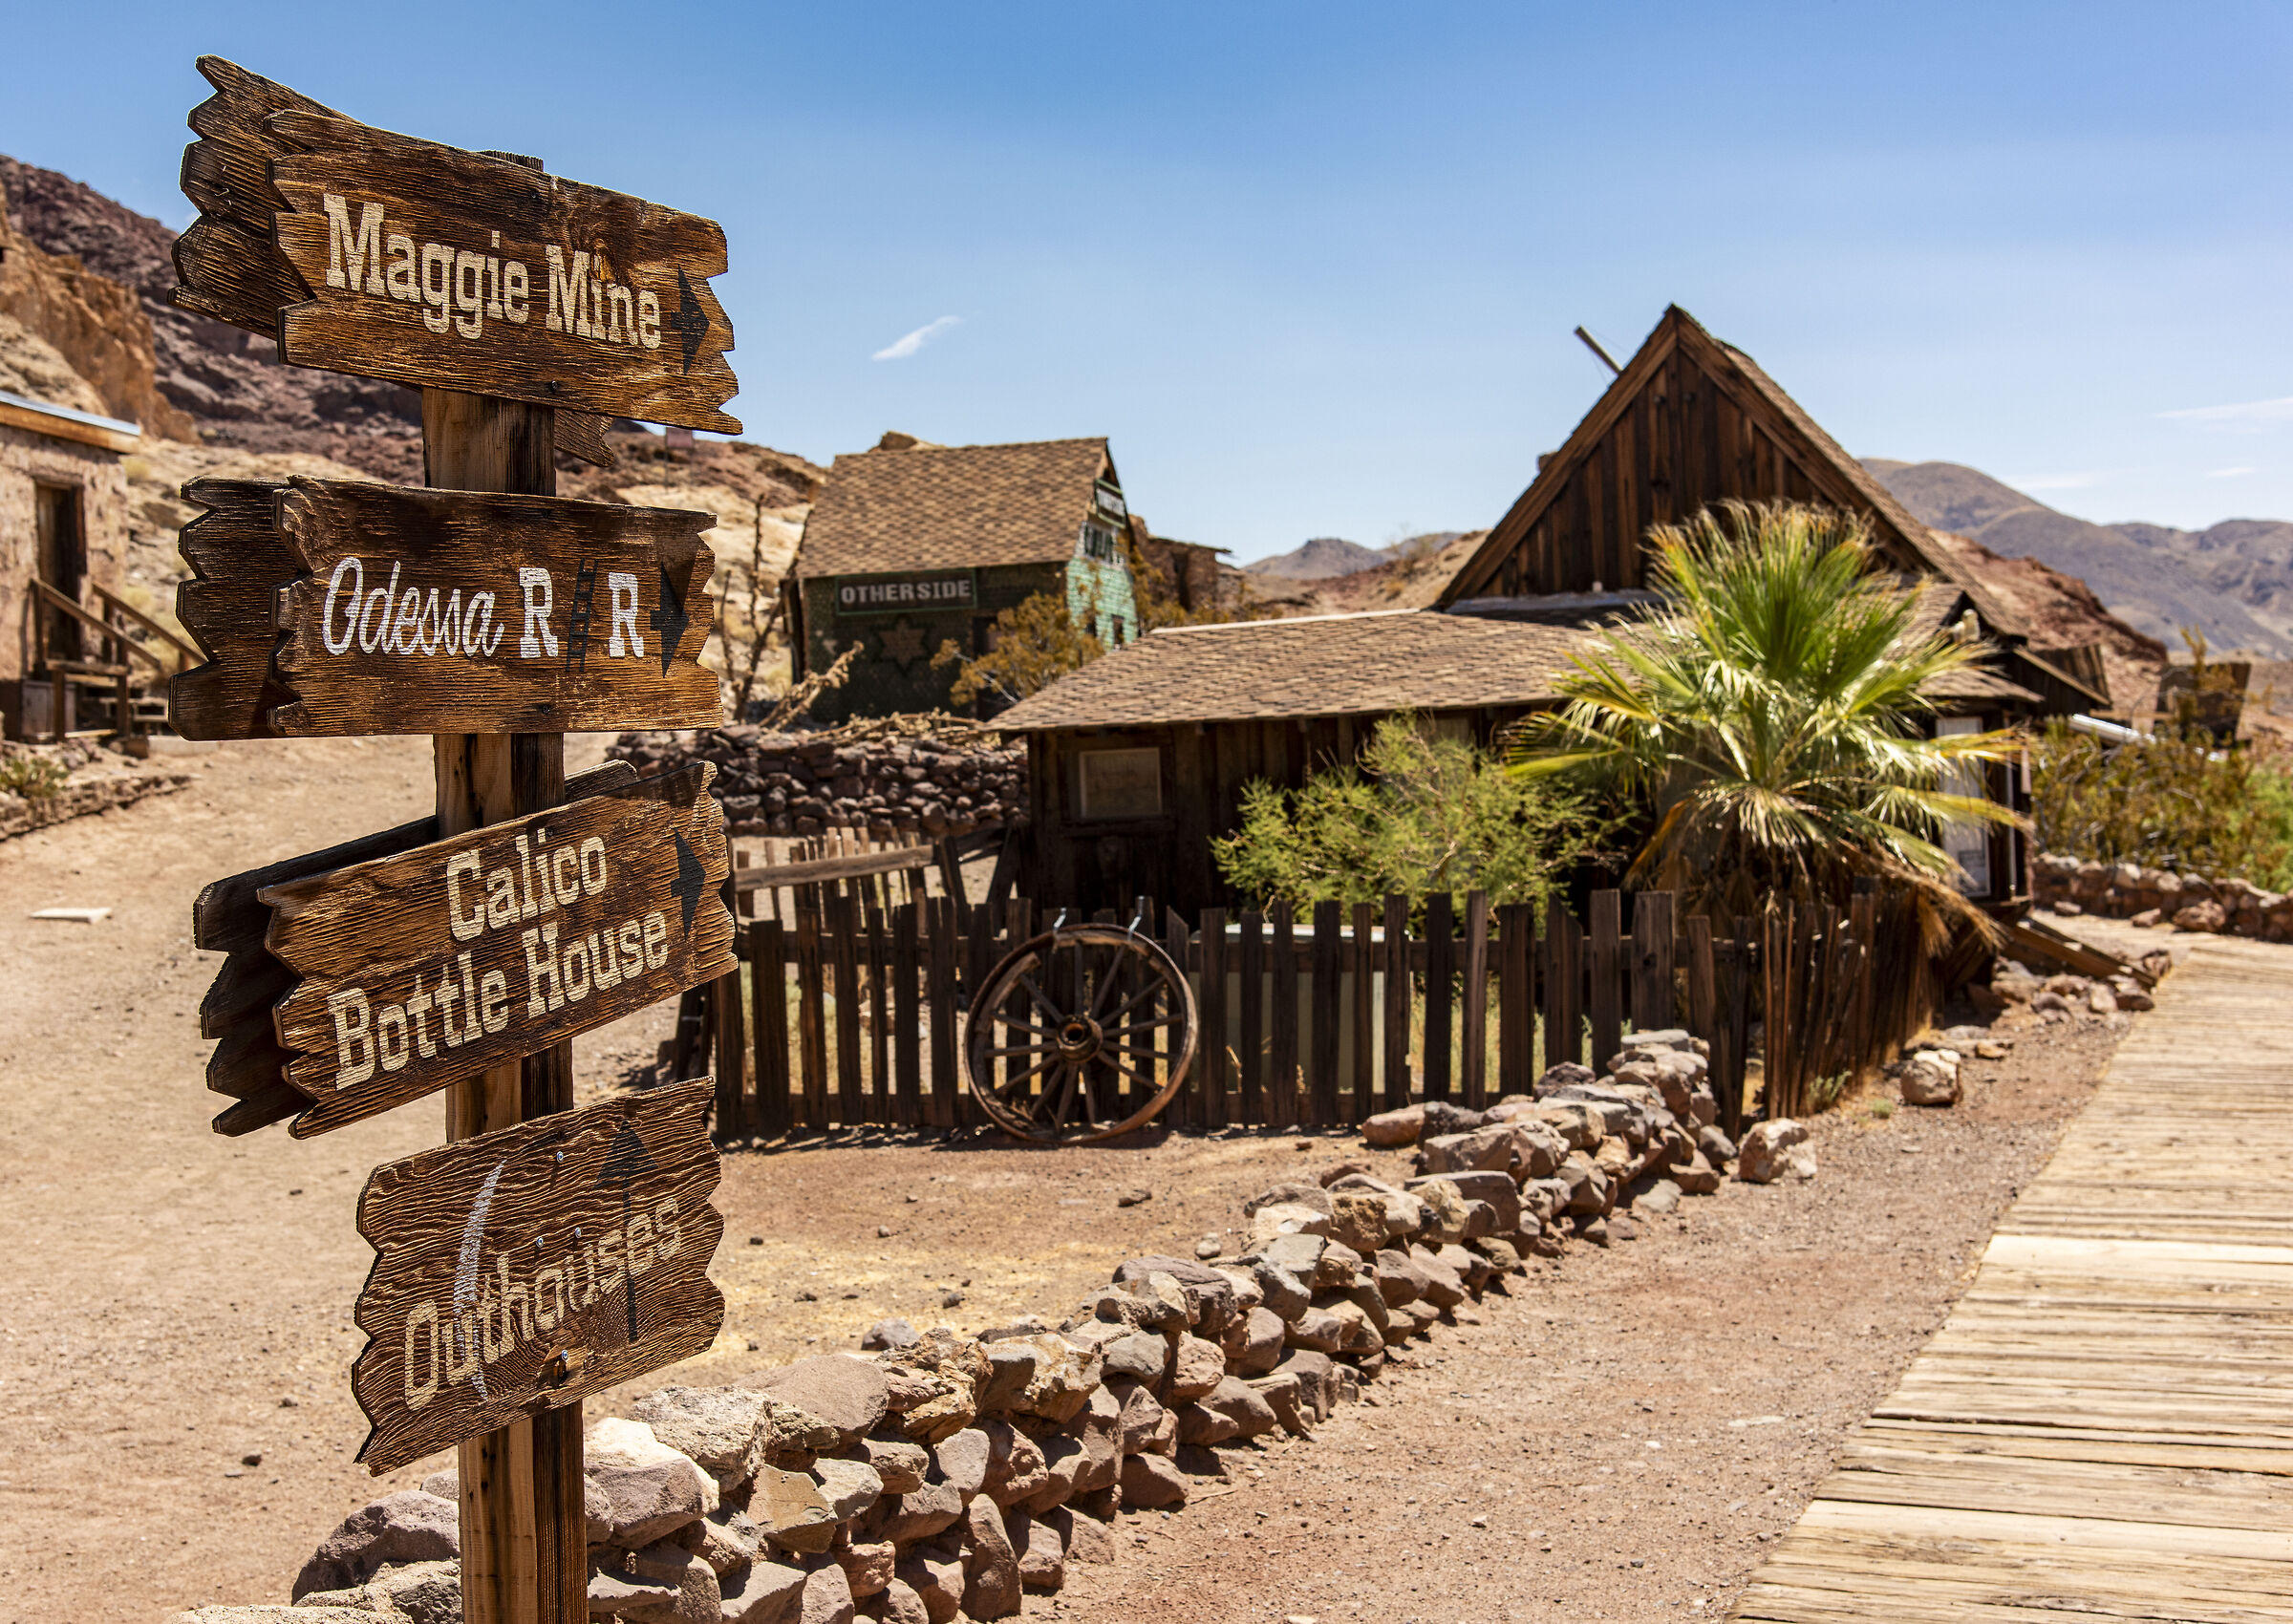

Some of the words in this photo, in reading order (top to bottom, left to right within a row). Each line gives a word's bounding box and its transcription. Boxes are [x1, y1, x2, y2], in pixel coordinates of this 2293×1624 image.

[323, 194, 529, 339] Maggie
[546, 245, 663, 350] Mine
[321, 556, 505, 659] Odessa
[519, 566, 560, 659] R
[608, 572, 645, 659] R
[446, 828, 608, 942] Calico
[327, 951, 510, 1091] Bottle
[521, 910, 669, 1019] House
[404, 1196, 682, 1412] Outhouses
